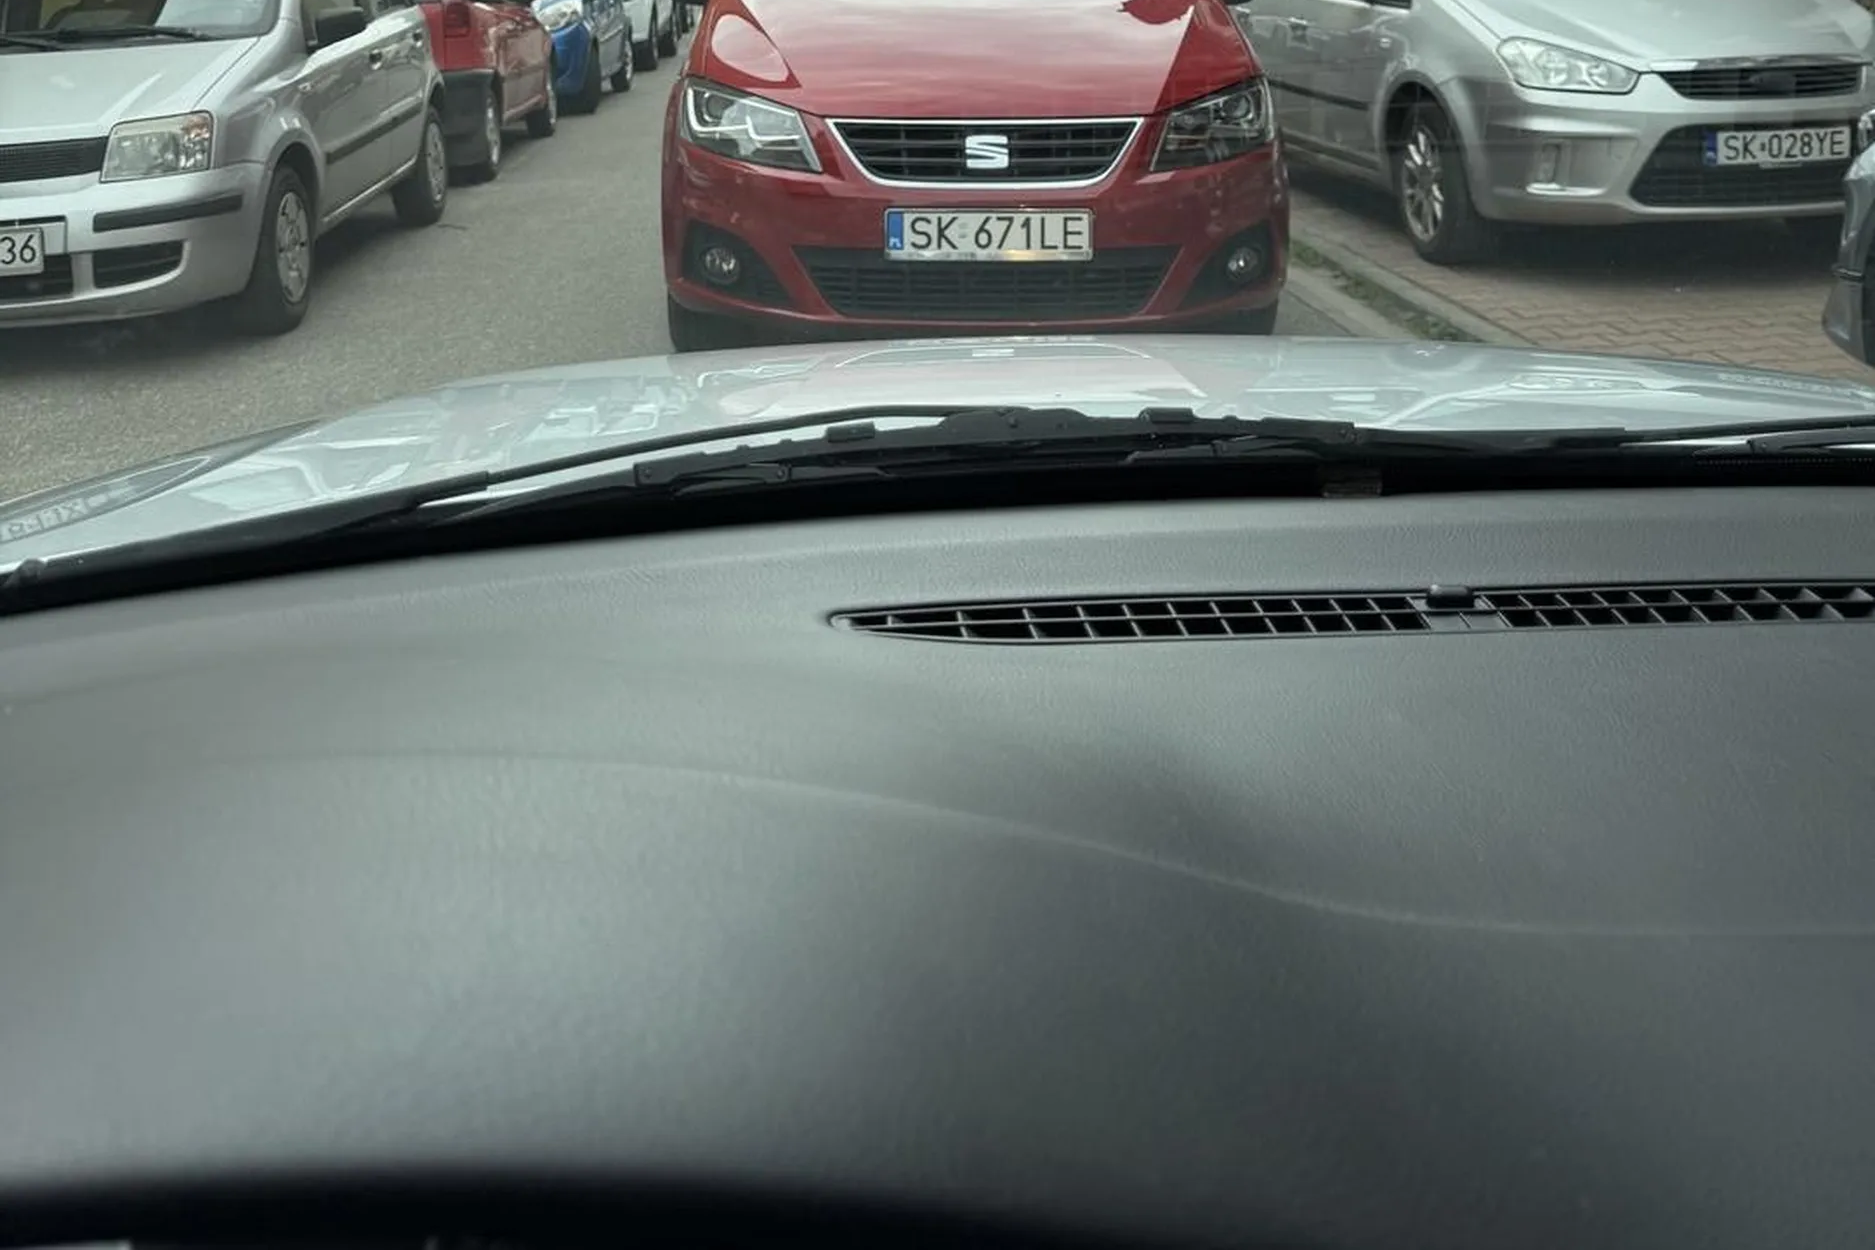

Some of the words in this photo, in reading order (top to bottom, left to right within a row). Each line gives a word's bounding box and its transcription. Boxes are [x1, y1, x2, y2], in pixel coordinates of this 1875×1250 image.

[0, 234, 36, 264] 36
[910, 216, 958, 250] SK
[974, 216, 1084, 250] 671LE
